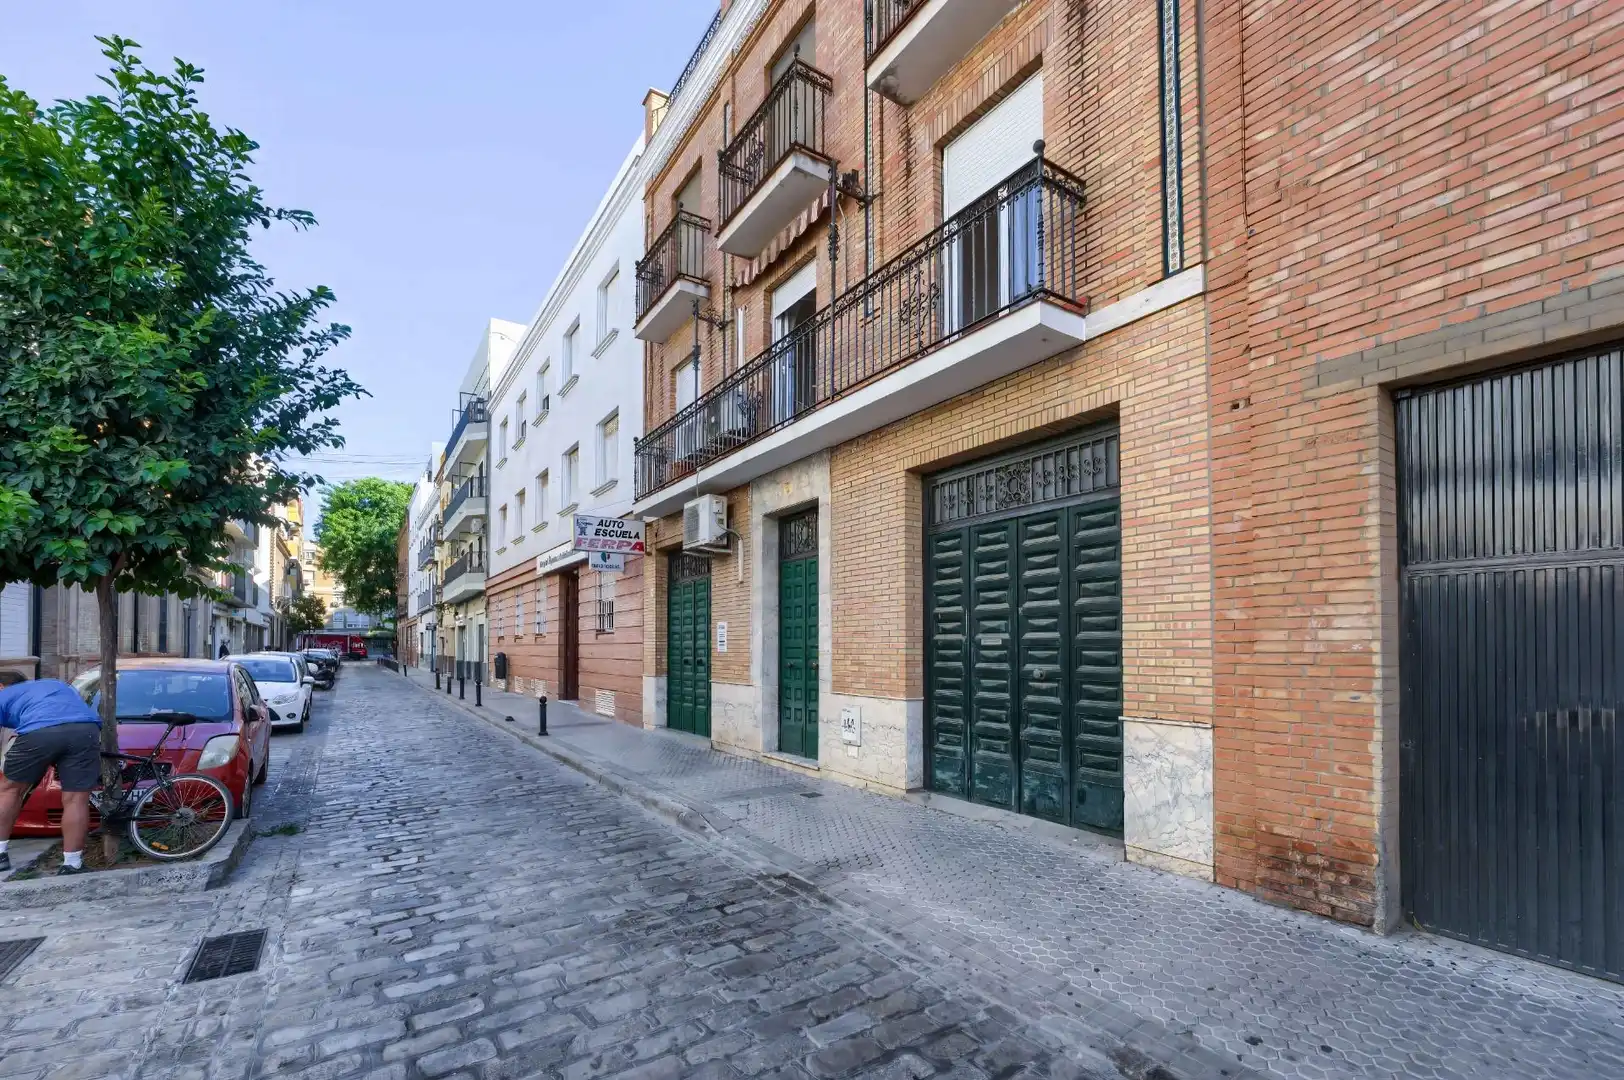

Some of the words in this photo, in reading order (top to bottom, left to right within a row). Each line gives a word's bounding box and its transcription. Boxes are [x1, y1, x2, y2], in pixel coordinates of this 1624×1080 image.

[597, 519, 624, 528] AUTO
[594, 528, 640, 539] ESCUELA
[575, 537, 644, 552] FERPA
